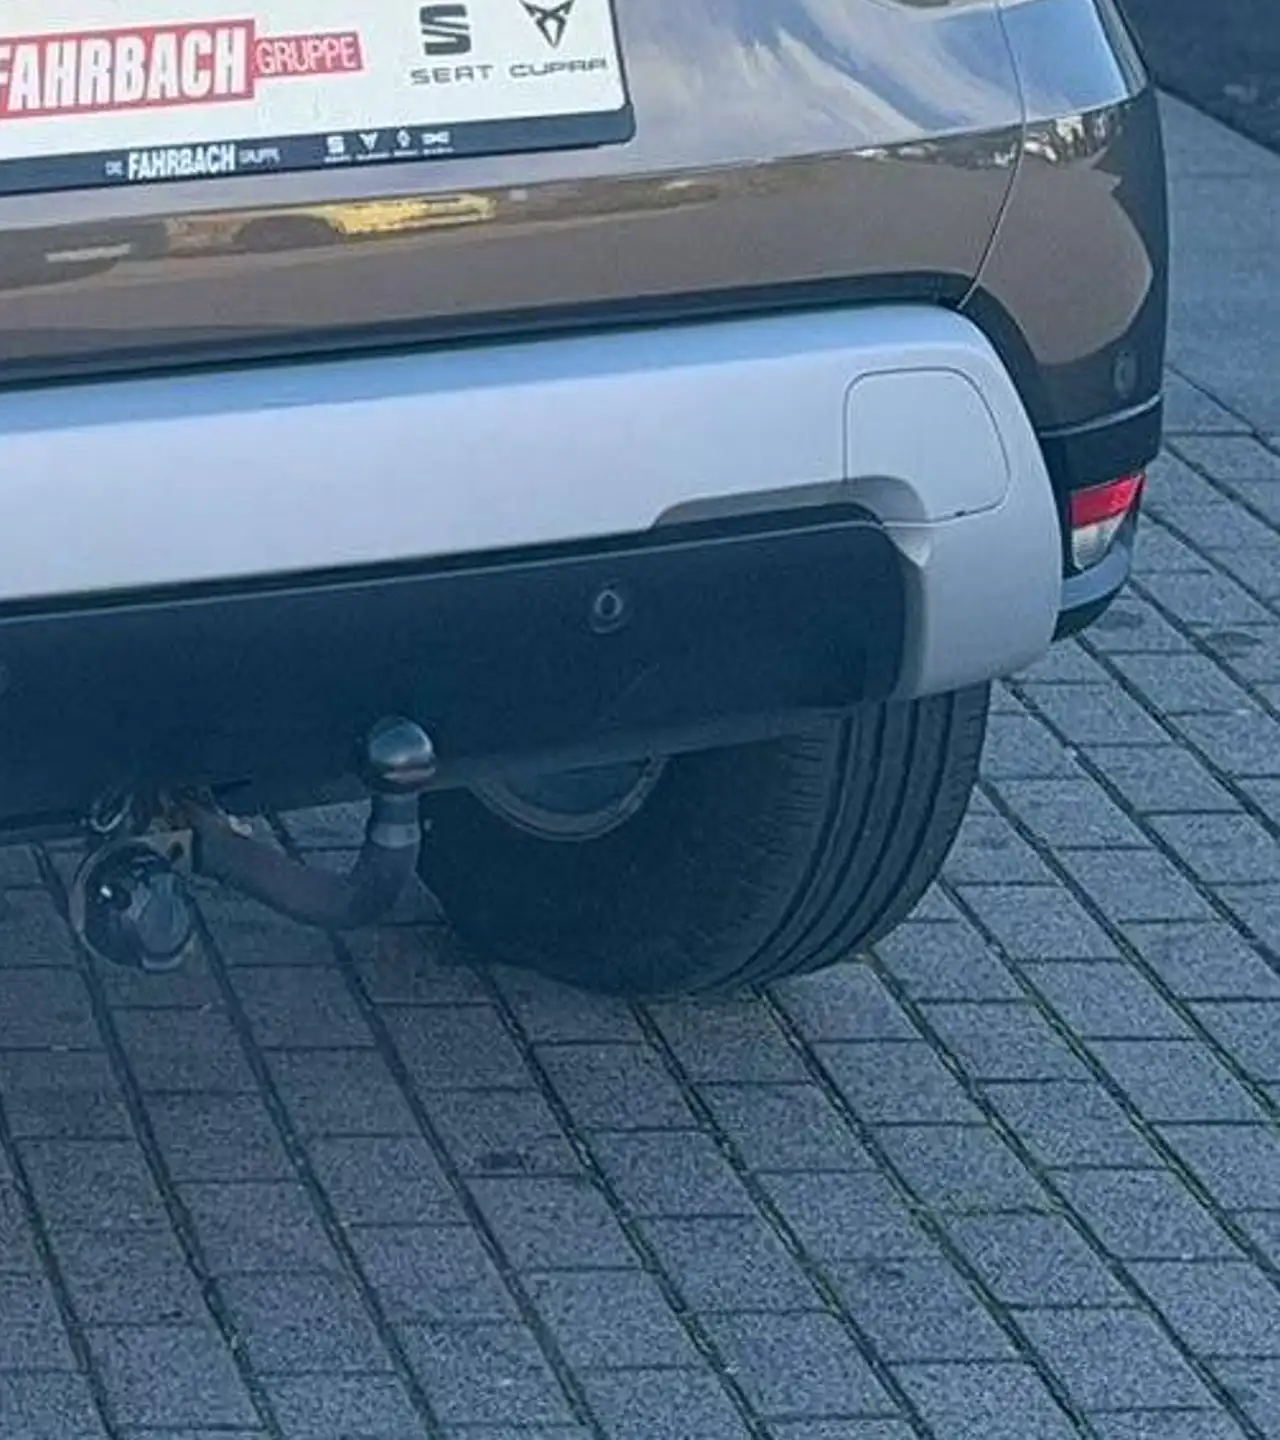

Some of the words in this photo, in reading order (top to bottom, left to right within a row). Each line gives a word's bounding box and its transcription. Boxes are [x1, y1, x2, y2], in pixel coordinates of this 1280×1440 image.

[254, 36, 359, 76] GRUPPE
[410, 64, 494, 86] SEAT
[508, 57, 610, 79] CUPRA
[128, 143, 237, 181] FAHRBACH
